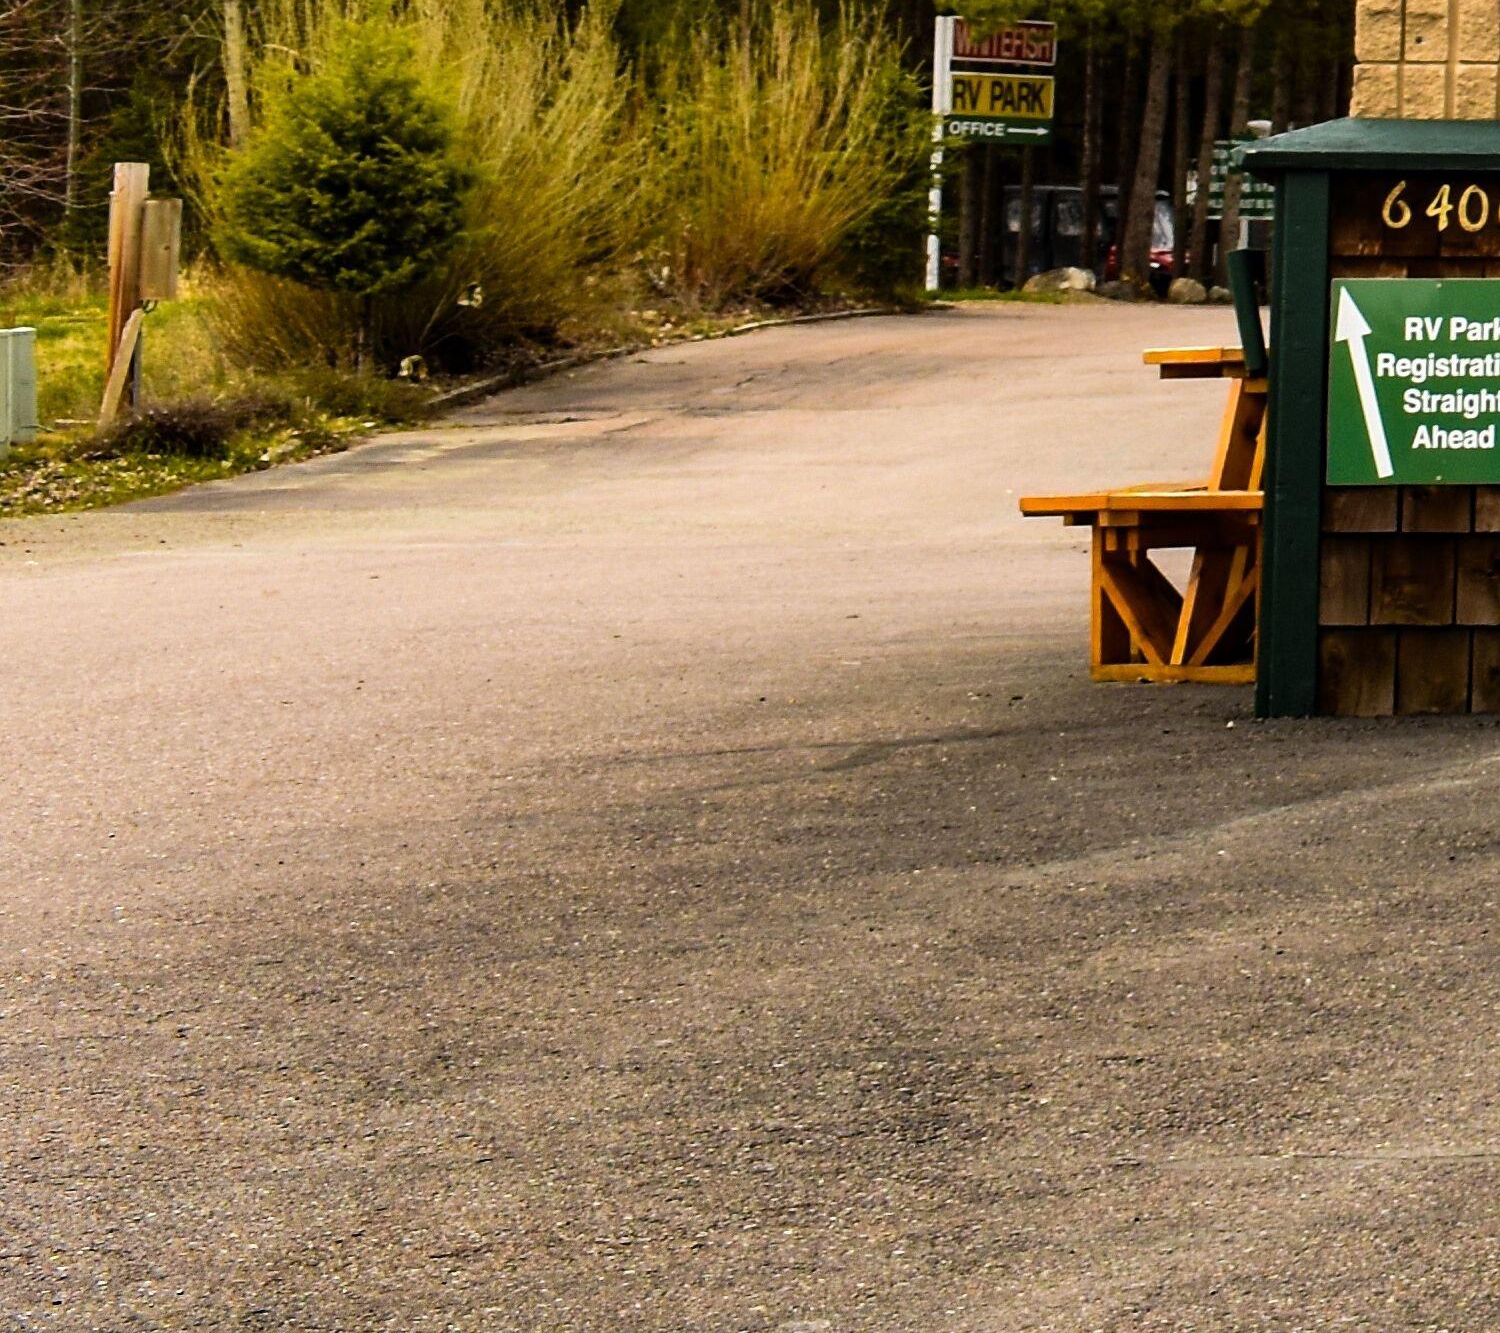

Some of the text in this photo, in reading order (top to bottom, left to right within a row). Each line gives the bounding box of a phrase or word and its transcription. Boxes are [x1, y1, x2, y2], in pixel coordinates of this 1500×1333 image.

[953, 79, 1045, 113] RV PARK
[949, 121, 1006, 136] OFFICE
[1404, 317, 1440, 341] RV
[1411, 425, 1495, 449] Ahead
